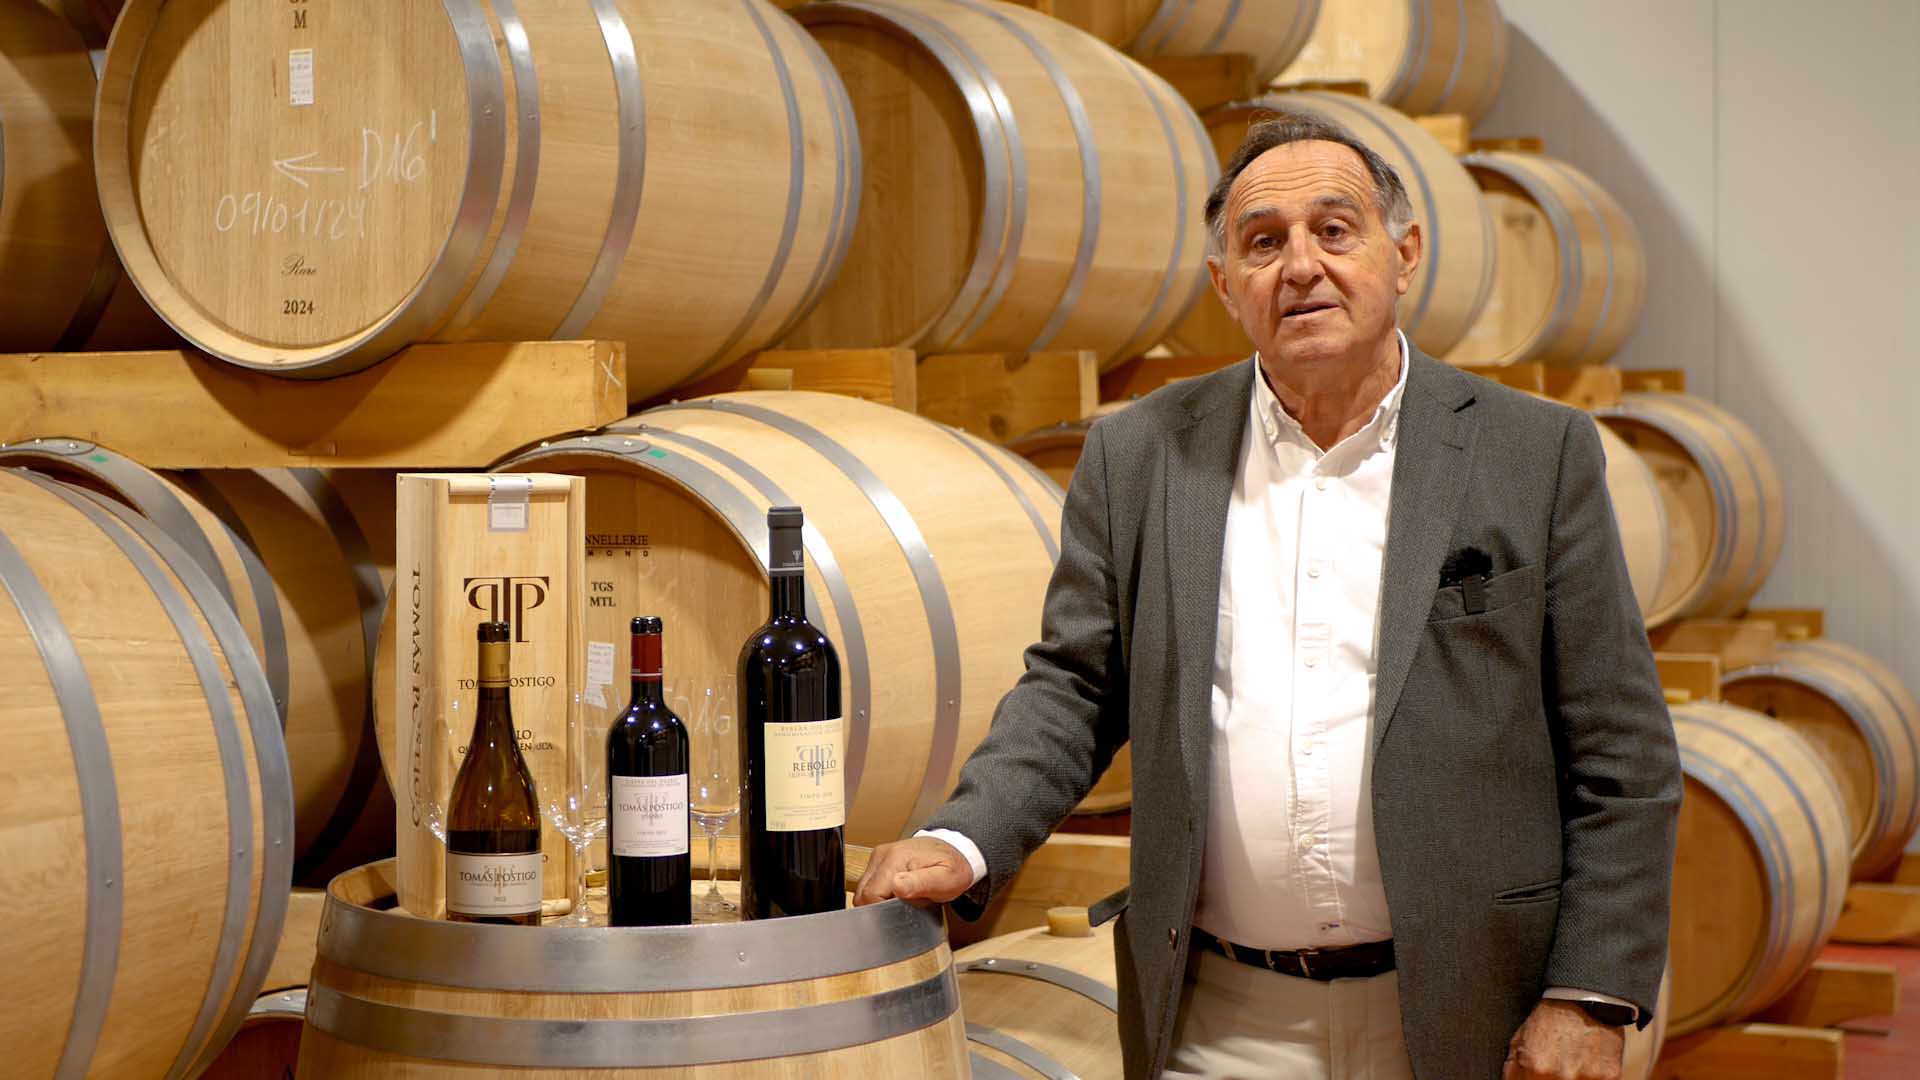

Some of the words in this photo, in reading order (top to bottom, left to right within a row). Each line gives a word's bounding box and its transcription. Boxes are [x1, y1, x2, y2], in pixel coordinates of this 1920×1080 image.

[283, 299, 315, 315] 2024
[590, 581, 614, 592] TGS
[589, 596, 617, 607] MTL
[509, 675, 556, 688] OSTIGO
[792, 759, 837, 772] REBOLLO
